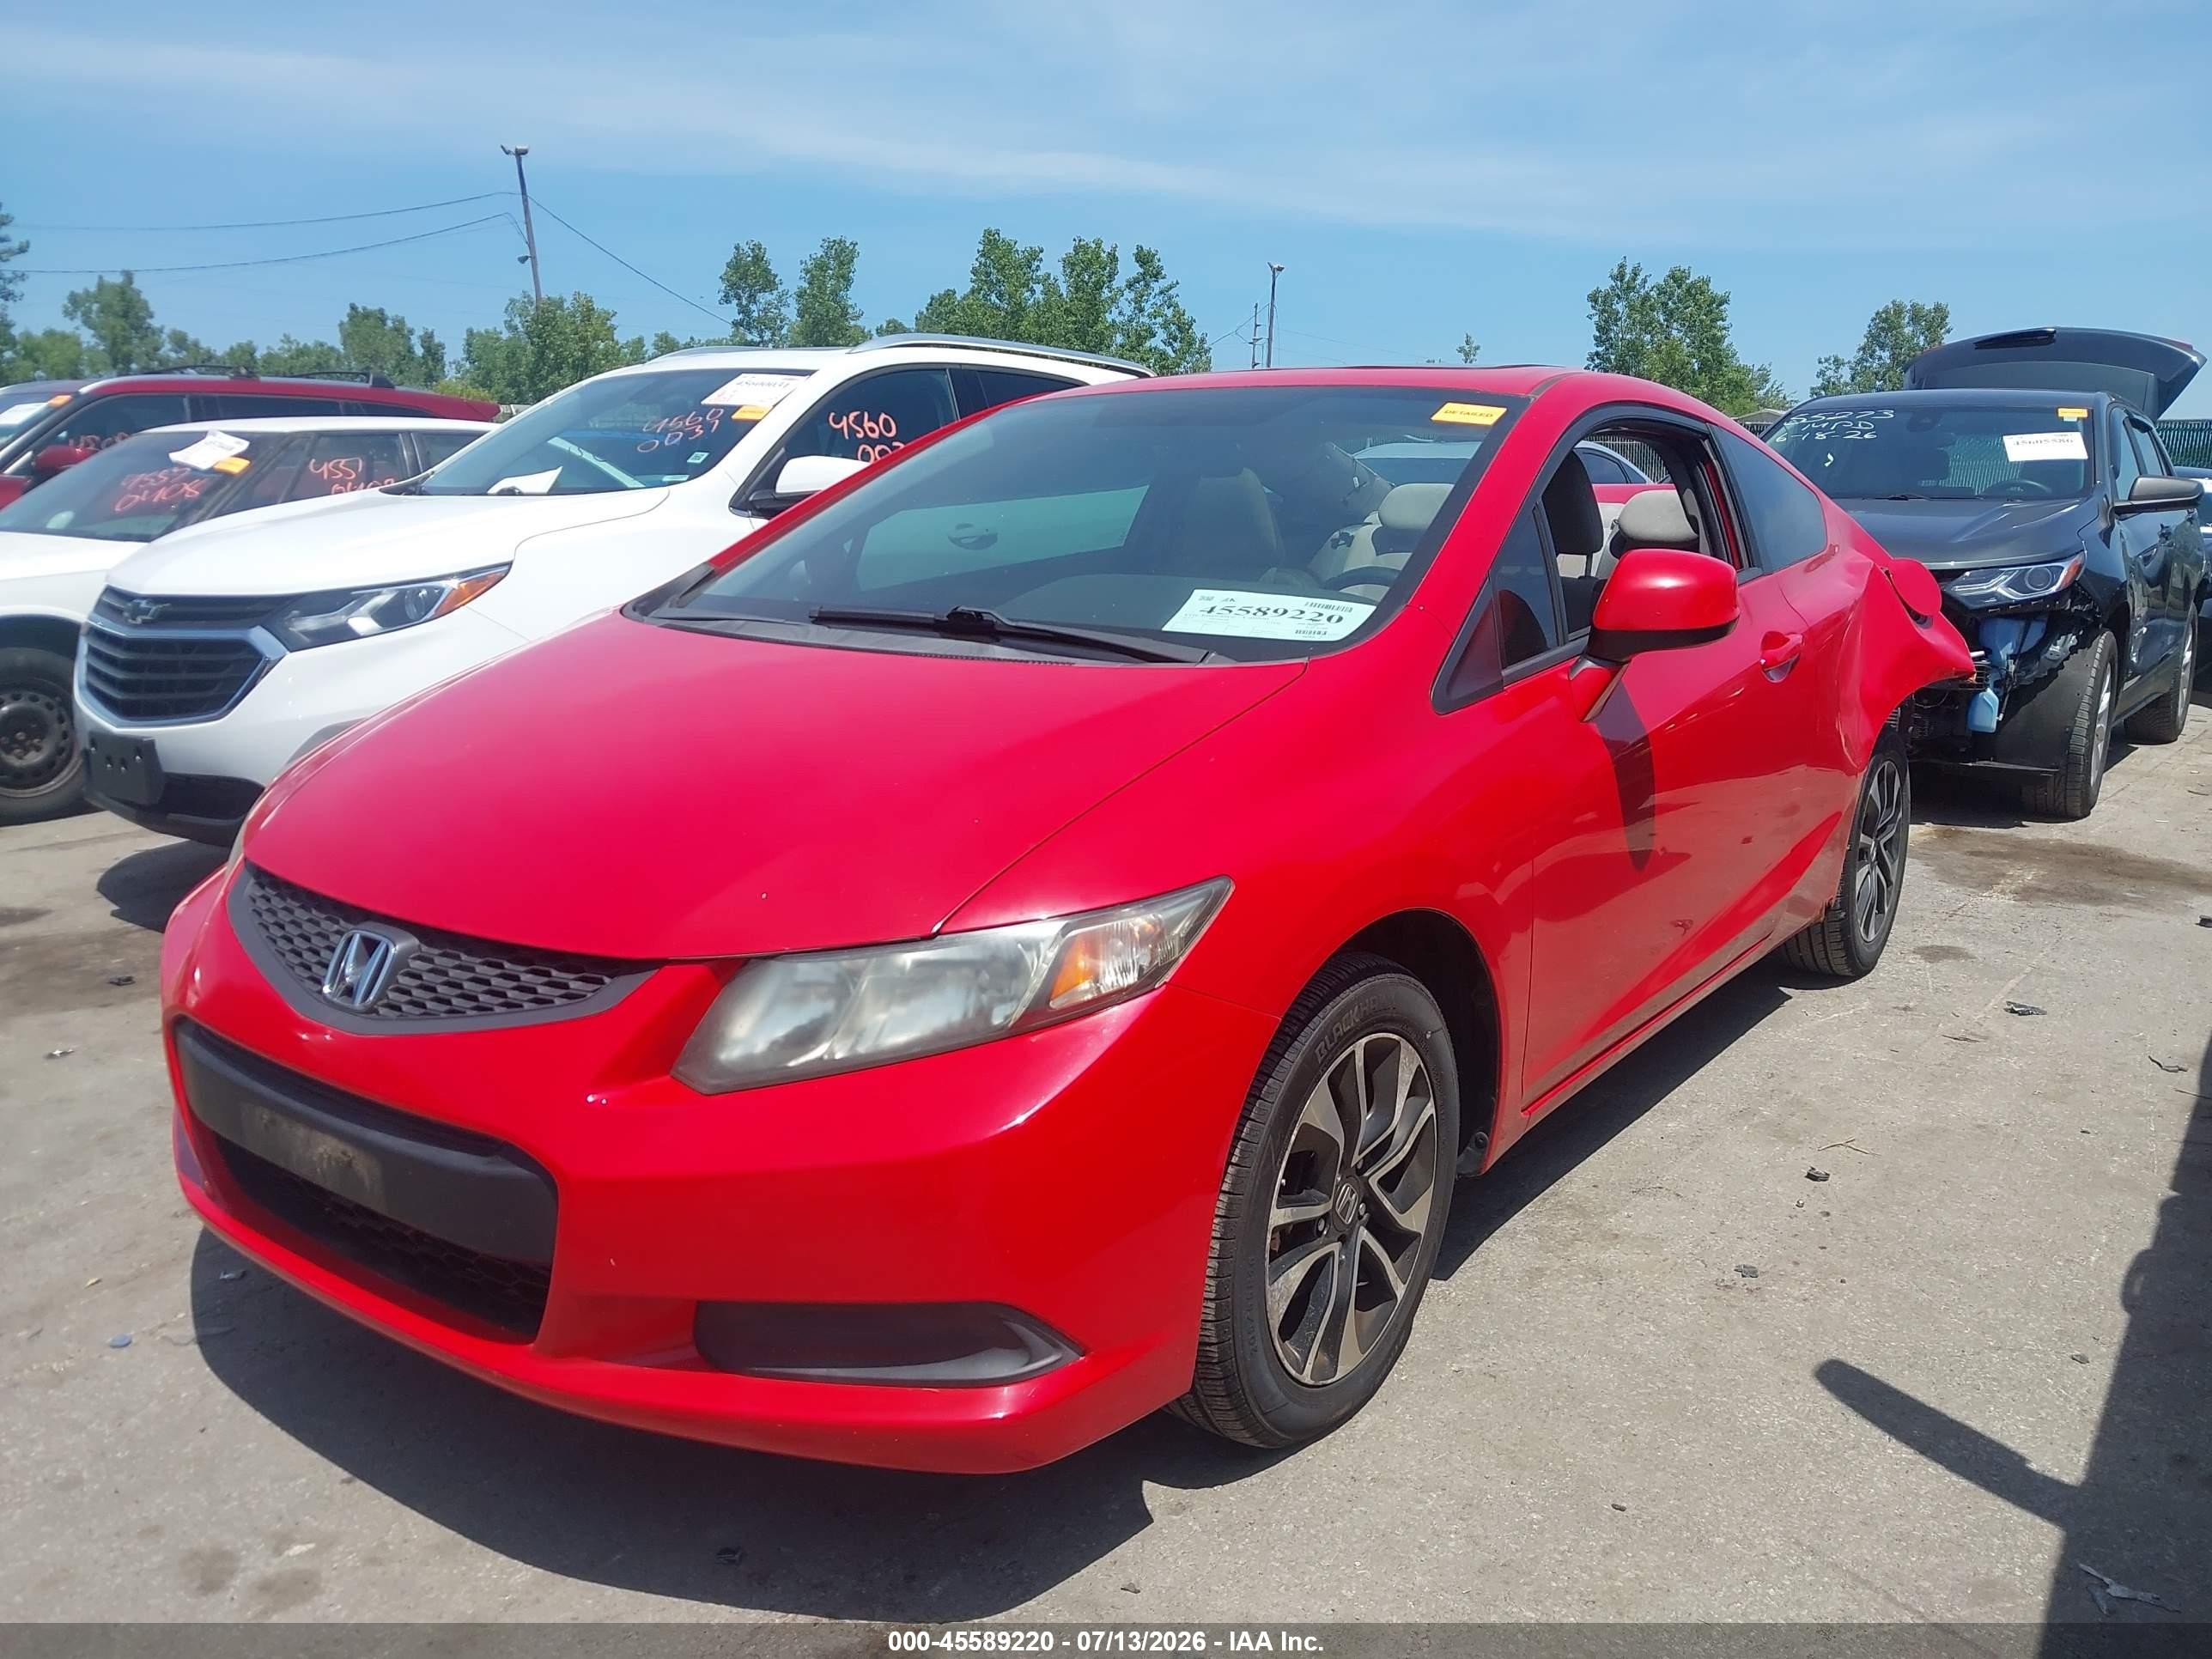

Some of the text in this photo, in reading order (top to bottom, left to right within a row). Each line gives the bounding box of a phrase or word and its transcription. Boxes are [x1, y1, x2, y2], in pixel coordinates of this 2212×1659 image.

[642, 408, 724, 433] 4560
[828, 410, 896, 440] 4560
[1776, 431, 1878, 442] 6-18-26
[309, 457, 362, 479] 4557
[1200, 605, 1344, 624] 45589220
